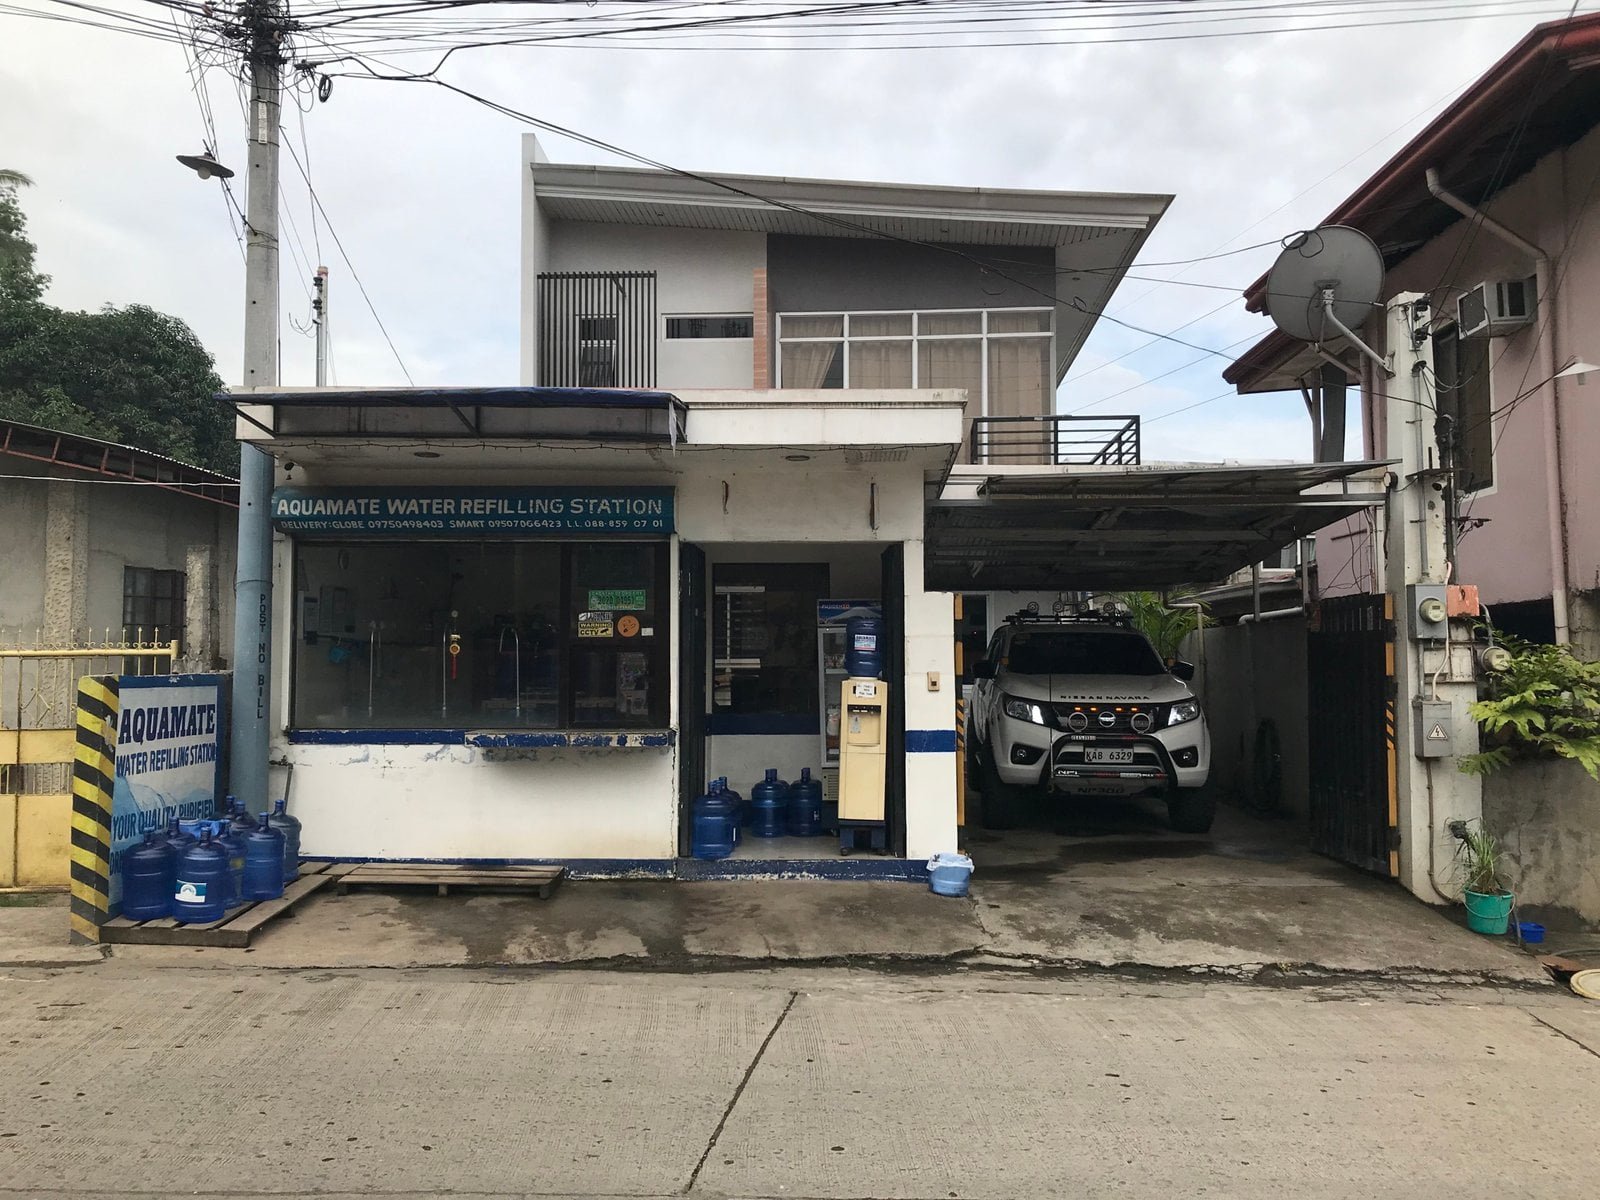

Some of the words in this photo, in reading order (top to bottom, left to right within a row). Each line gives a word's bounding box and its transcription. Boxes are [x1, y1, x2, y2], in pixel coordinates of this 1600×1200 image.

[277, 499, 380, 516] AQUAMATE
[387, 499, 455, 515] WATER
[461, 498, 564, 514] REFILLING
[570, 498, 662, 514] STATION
[367, 520, 444, 529] 09750498403
[449, 520, 484, 528] SMART
[258, 643, 266, 664] NO
[257, 674, 265, 719] BILL
[118, 703, 215, 746] AQUAMATE
[116, 751, 147, 778] WATER
[149, 745, 189, 773] REFILLING
[189, 742, 216, 766] STATION
[1086, 750, 1103, 761] KAB
[1109, 750, 1132, 761] 6329
[111, 813, 137, 842] YOUR
[138, 804, 177, 835] QUALITY
[178, 799, 214, 820] PURIFIED
